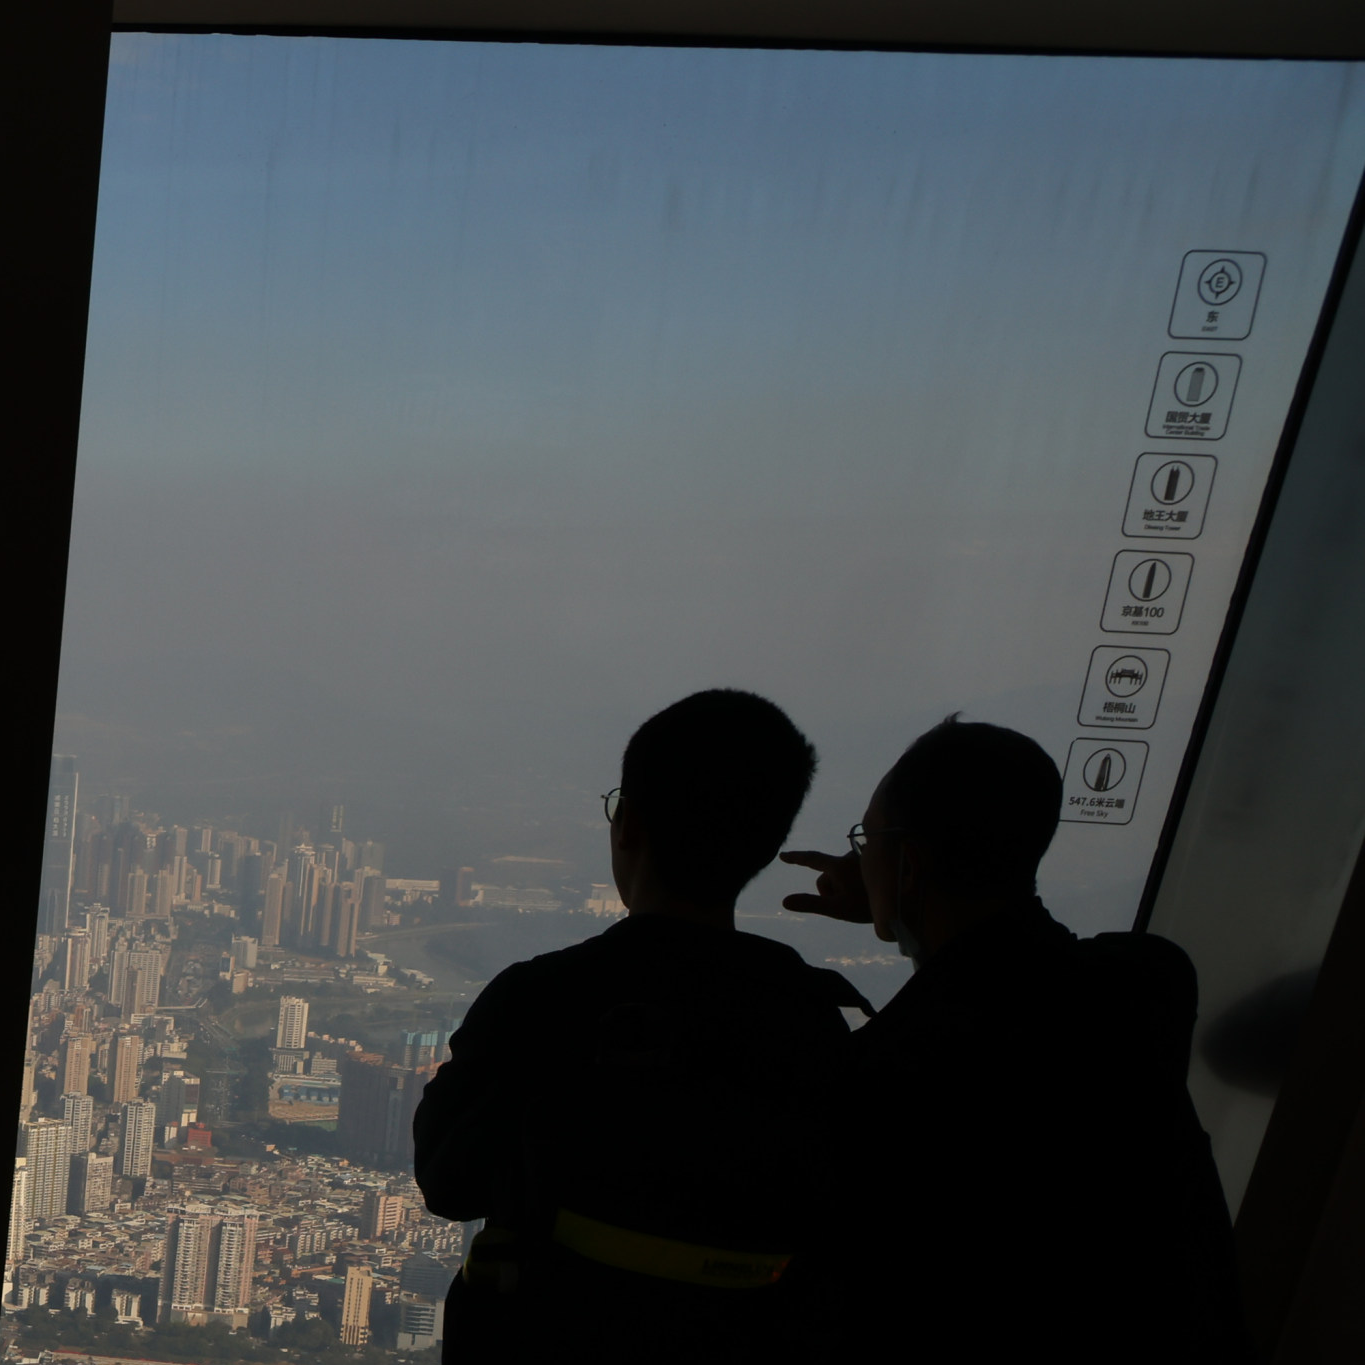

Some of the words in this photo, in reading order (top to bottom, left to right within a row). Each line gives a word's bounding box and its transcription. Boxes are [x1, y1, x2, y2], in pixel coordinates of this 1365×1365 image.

[1215, 277, 1225, 288] E
[1206, 310, 1220, 323] 东
[1165, 410, 1212, 424] 国贸大厦
[1142, 509, 1189, 522] 地王大厦
[1121, 605, 1165, 618] 京基100
[1103, 701, 1137, 714] 梧桐山
[1080, 809, 1095, 817] Free
[1096, 810, 1108, 819] Sky
